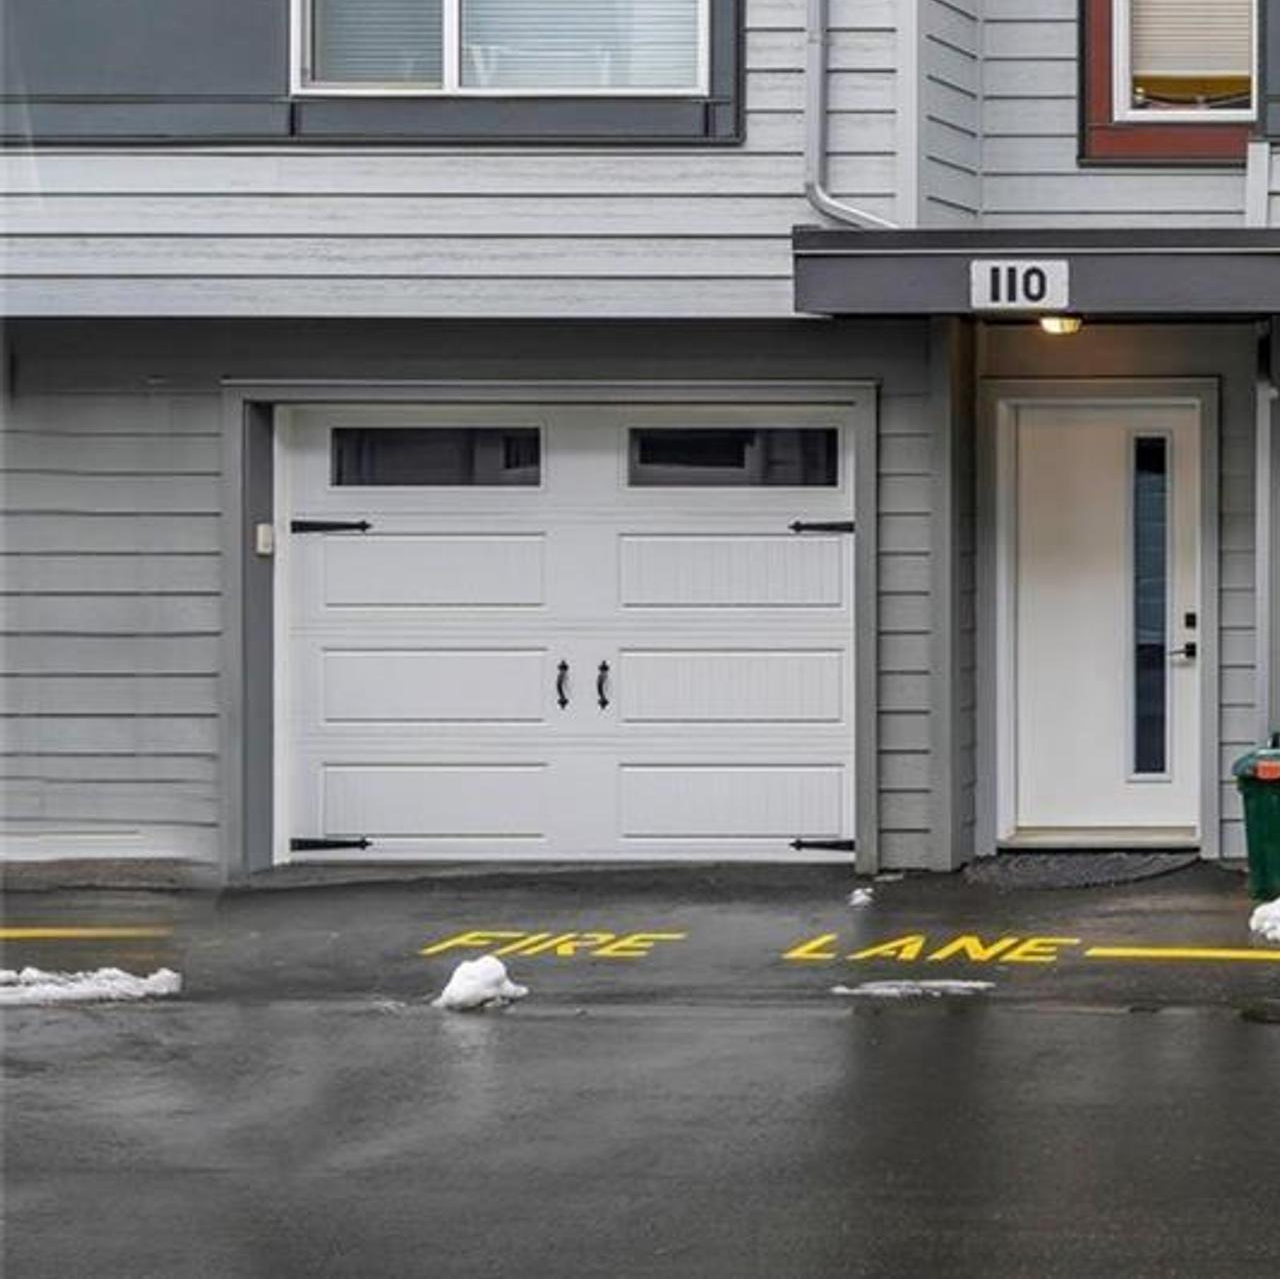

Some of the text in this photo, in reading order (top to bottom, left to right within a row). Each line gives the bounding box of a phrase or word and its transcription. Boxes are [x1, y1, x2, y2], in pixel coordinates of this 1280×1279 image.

[990, 266, 1047, 303] 110
[419, 930, 1082, 961] FIRE LANE
